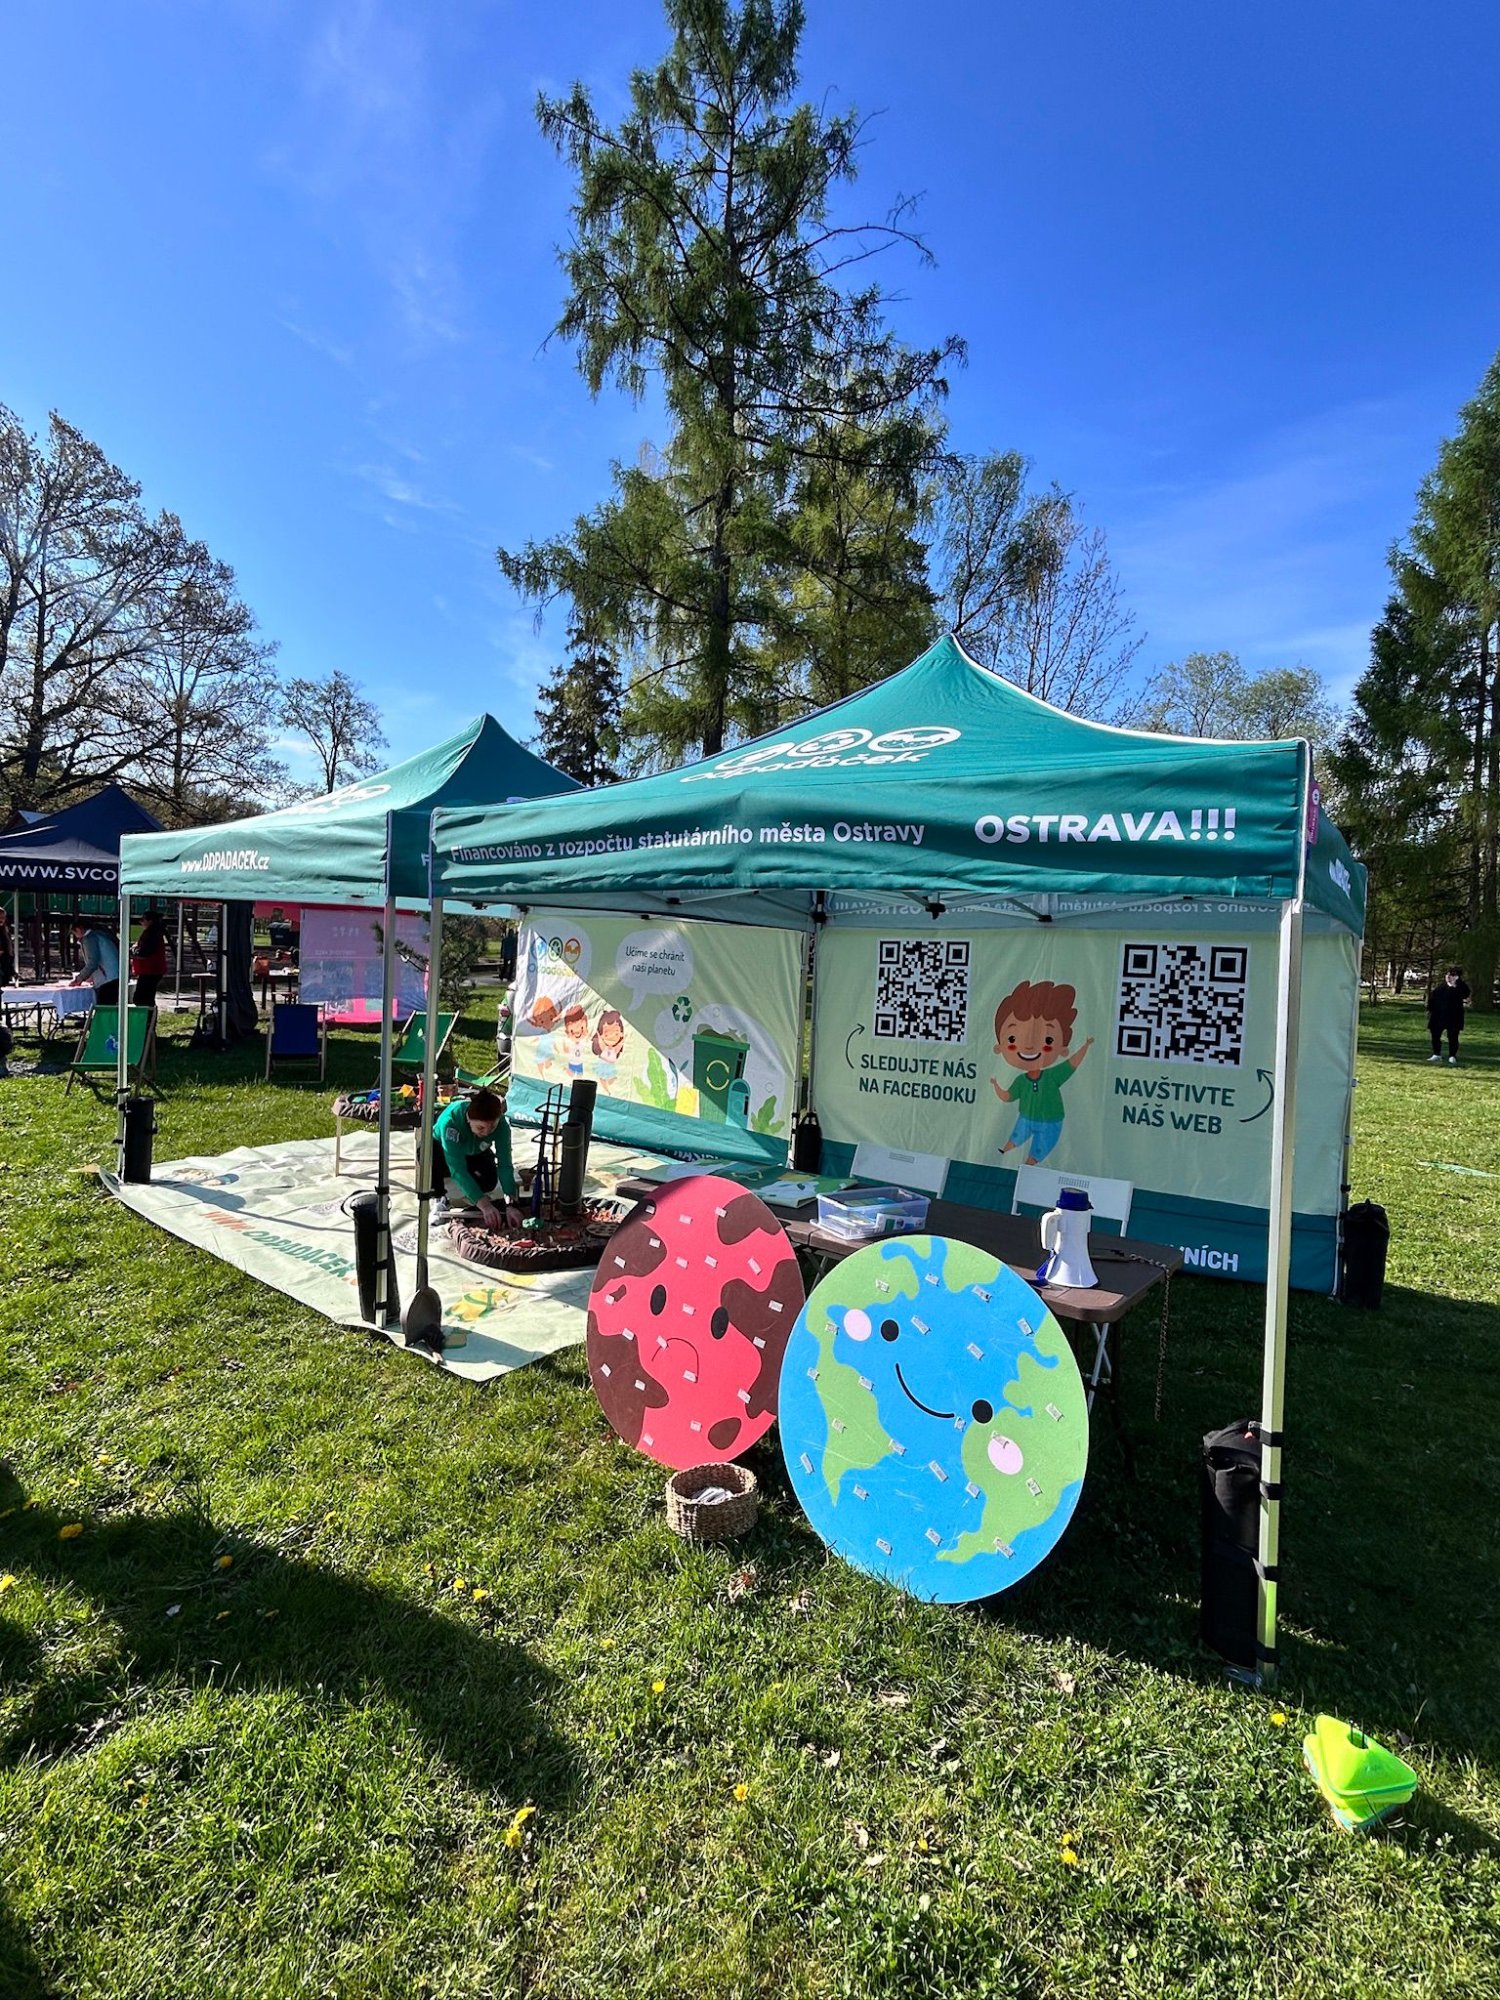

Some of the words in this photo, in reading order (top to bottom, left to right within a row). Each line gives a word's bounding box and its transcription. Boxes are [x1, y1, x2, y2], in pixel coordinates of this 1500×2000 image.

[974, 808, 1236, 845] OSTRAVA!!!
[451, 841, 542, 863] Financováno
[546, 845, 555, 857] z
[559, 834, 633, 857] rozpočtu
[639, 825, 753, 850] statutárního
[759, 822, 825, 844] města
[833, 822, 925, 846] Ostravy
[649, 950, 658, 959] se
[659, 948, 685, 962] chránit
[647, 963, 676, 976] planetu
[860, 1054, 939, 1075] SLEDUJTE
[943, 1058, 977, 1079] NÁS
[859, 1077, 879, 1093] NA
[883, 1079, 976, 1104] FACEBOOKU
[1114, 1076, 1236, 1107] NAVŠTIVTE
[1122, 1102, 1164, 1128] NÁŠ
[1170, 1111, 1222, 1135] WEB
[1179, 1244, 1239, 1272] NÍCH
